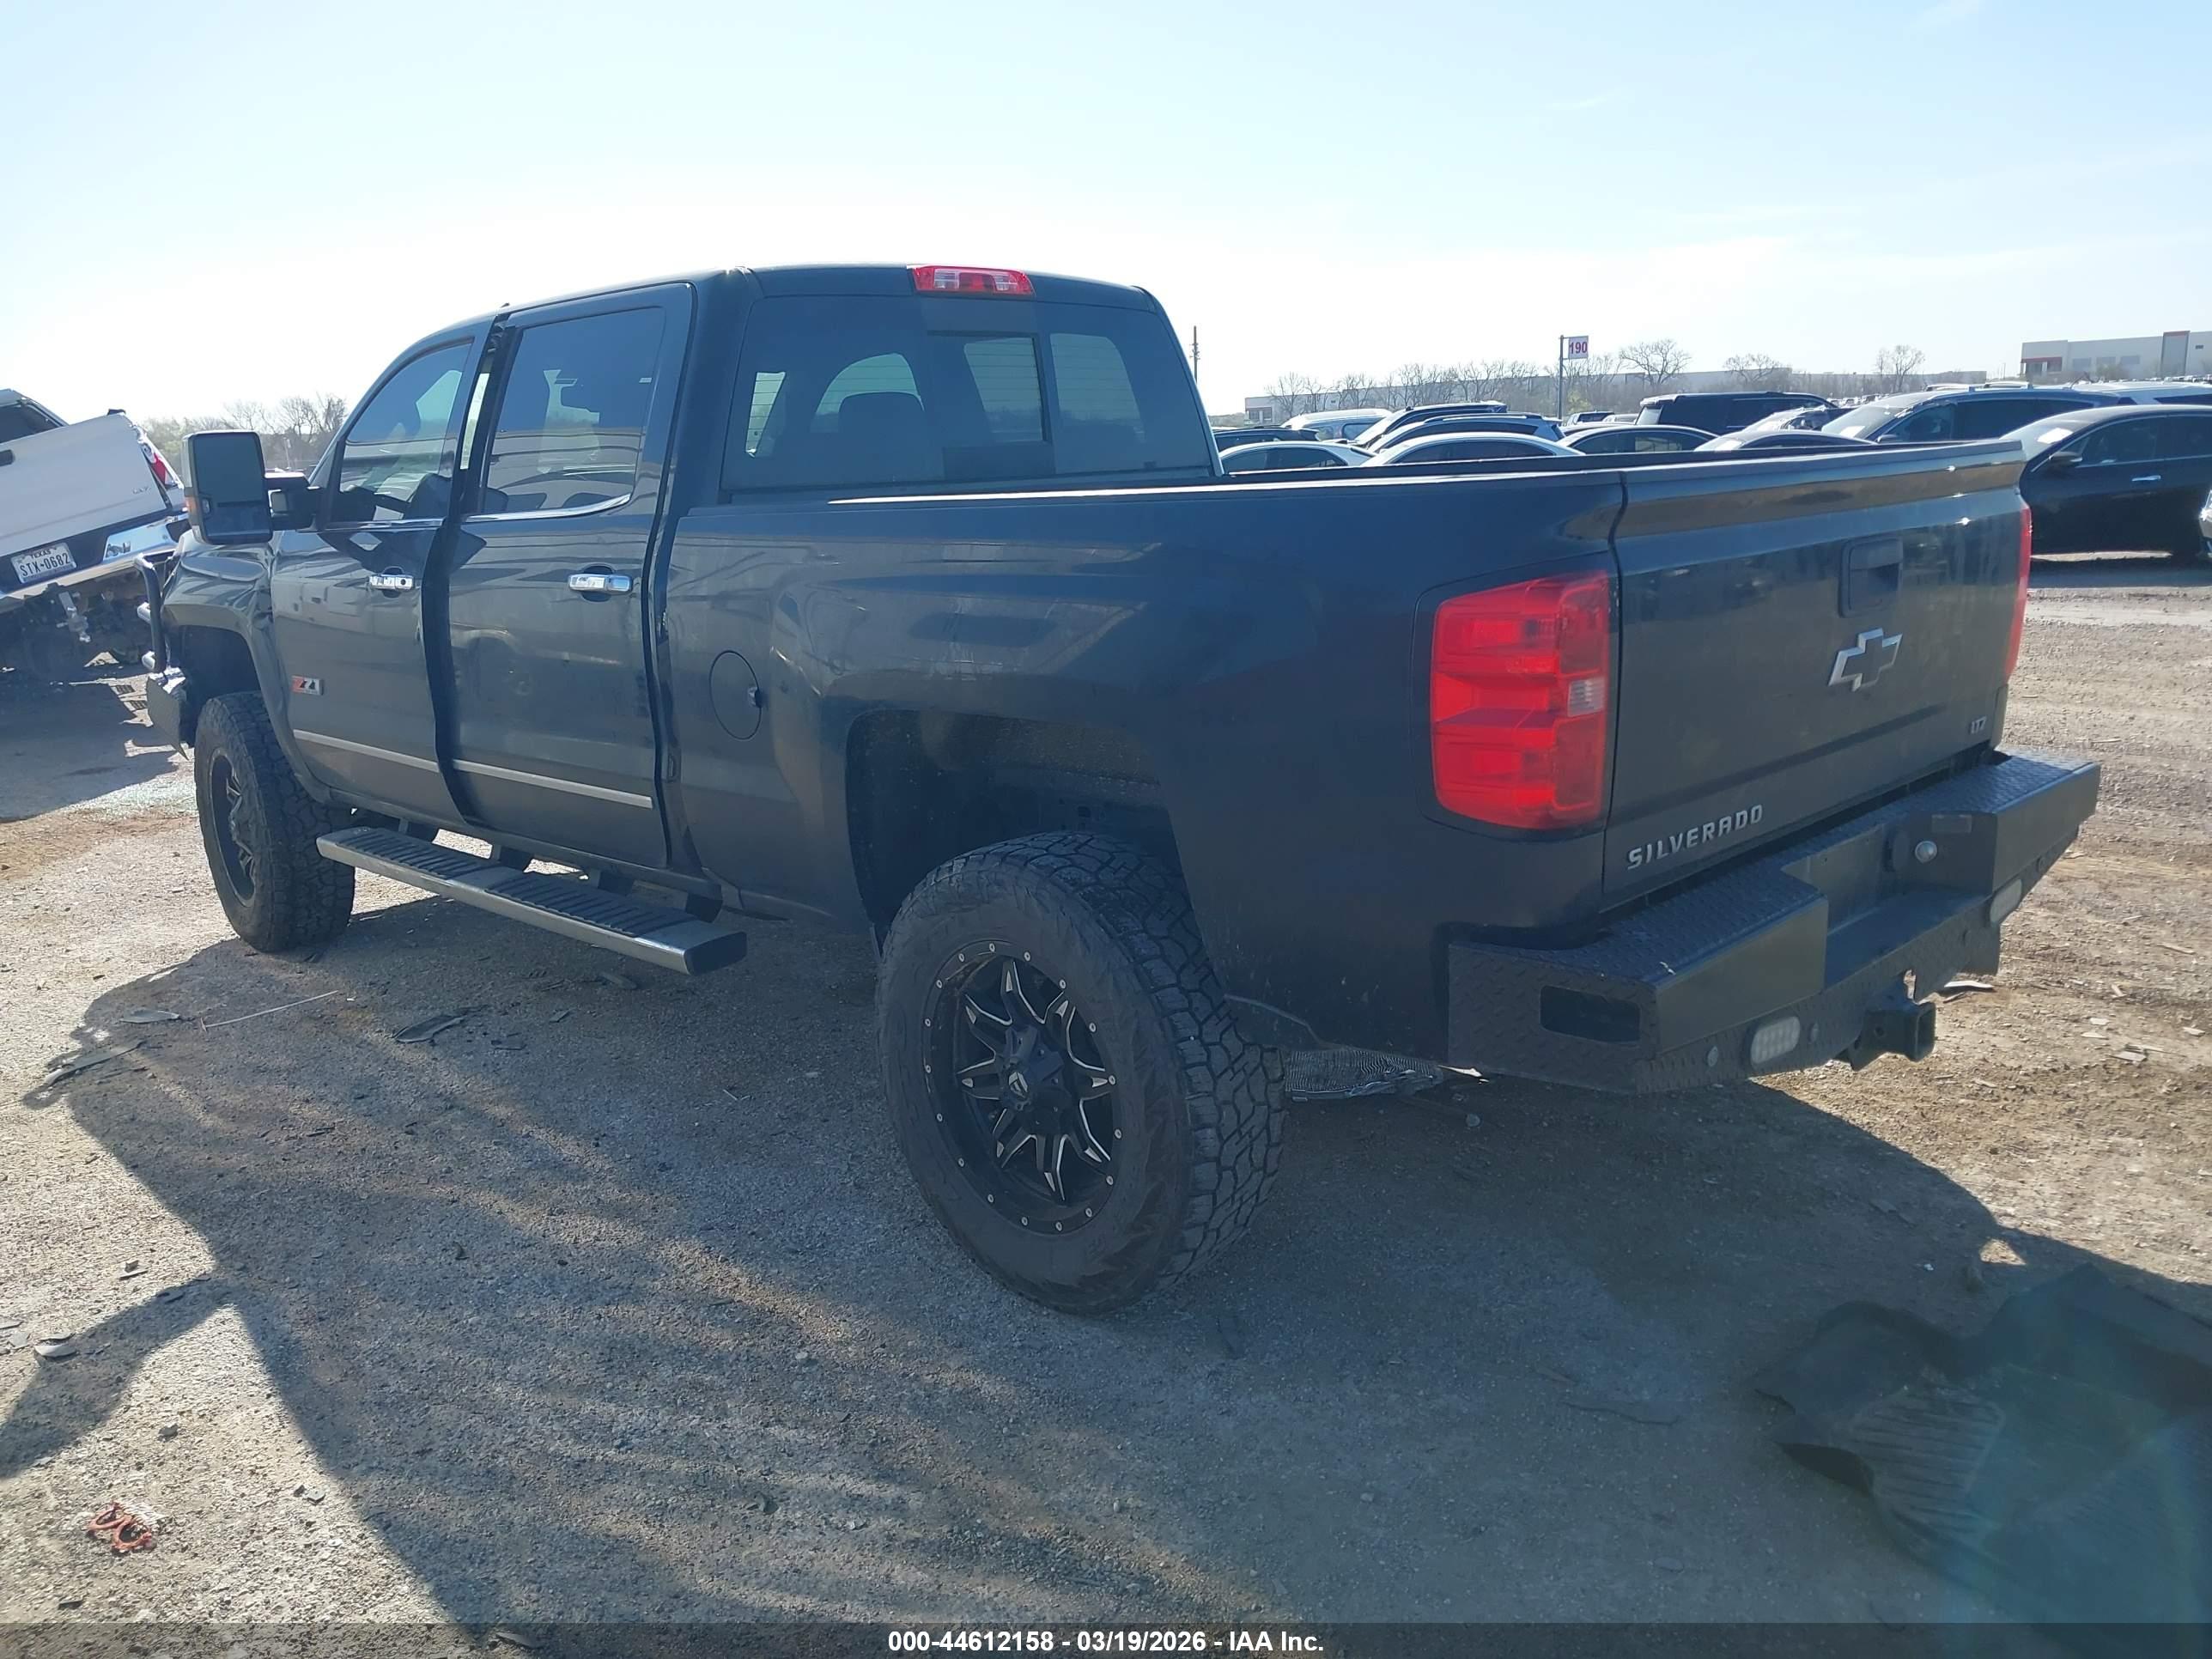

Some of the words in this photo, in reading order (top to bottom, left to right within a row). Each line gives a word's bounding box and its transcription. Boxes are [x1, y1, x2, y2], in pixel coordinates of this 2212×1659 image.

[1570, 342, 1588, 354] 190
[31, 549, 52, 559] TEXAS
[1627, 804, 1763, 870] SILVERADO
